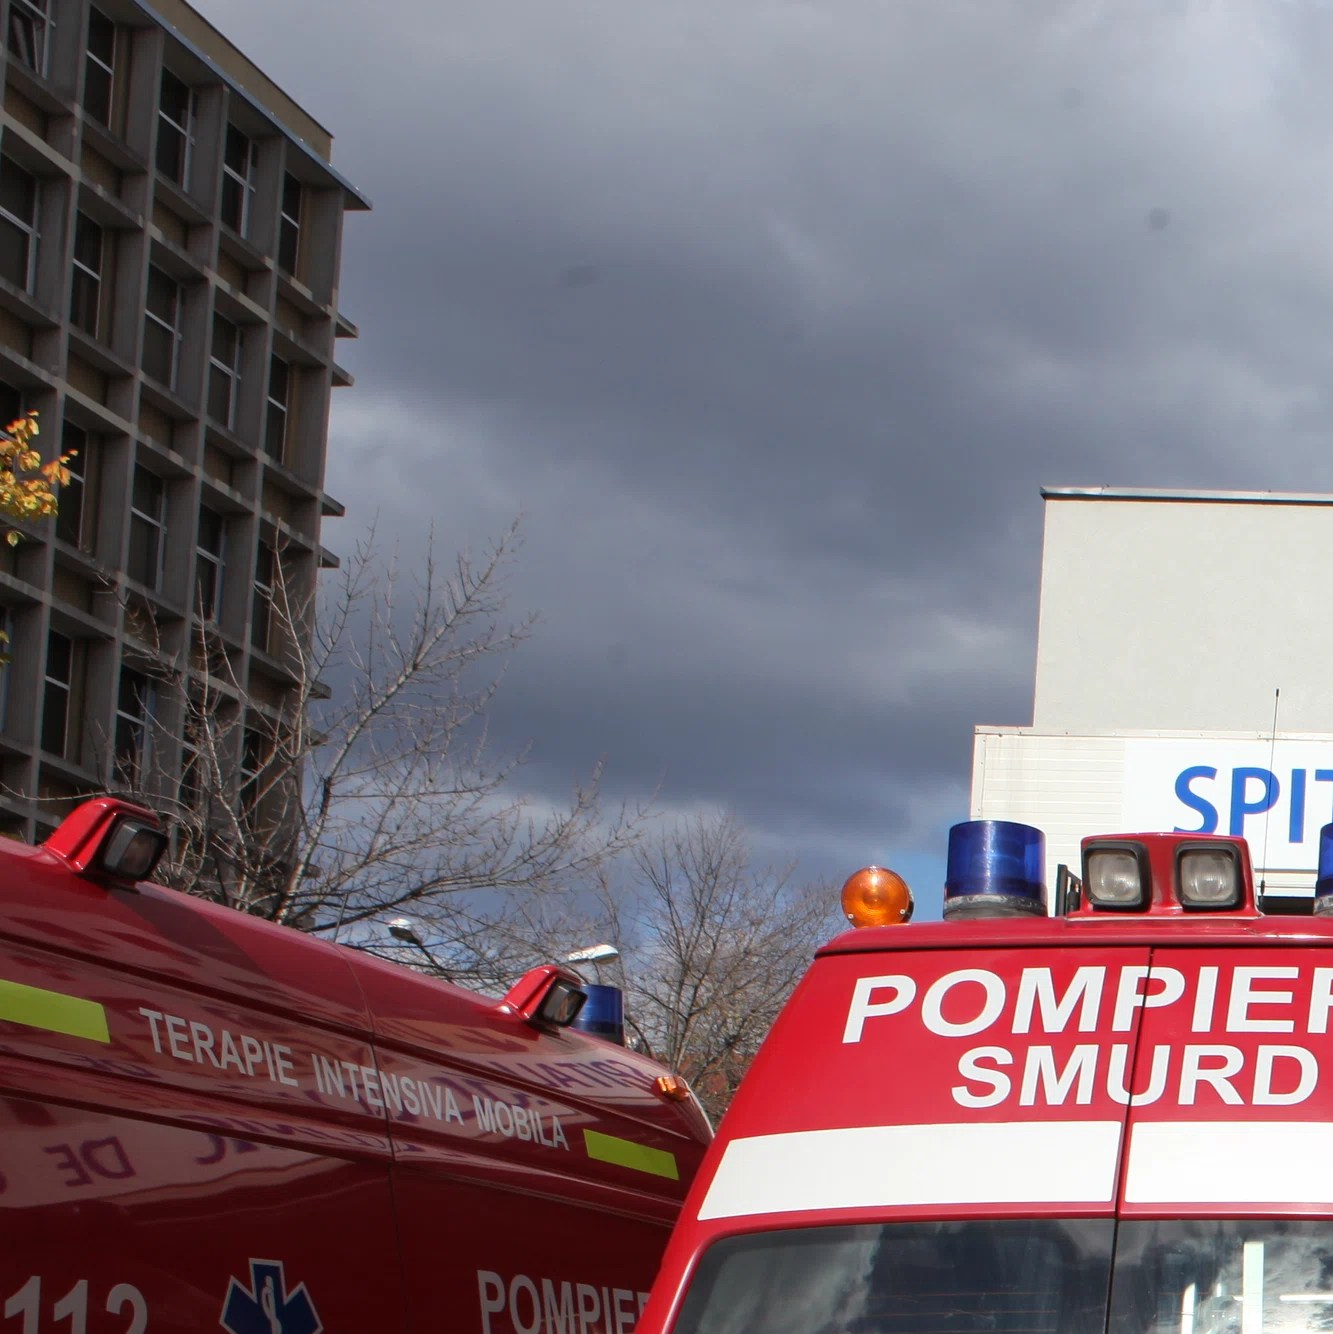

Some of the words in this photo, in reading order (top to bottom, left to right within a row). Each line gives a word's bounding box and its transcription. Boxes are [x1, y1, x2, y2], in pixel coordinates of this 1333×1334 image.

[139, 1006, 298, 1087] TERAPIE
[311, 1053, 464, 1126] INTENSIVA
[474, 1095, 569, 1151] MOBILA
[952, 1044, 1318, 1108] SMURD
